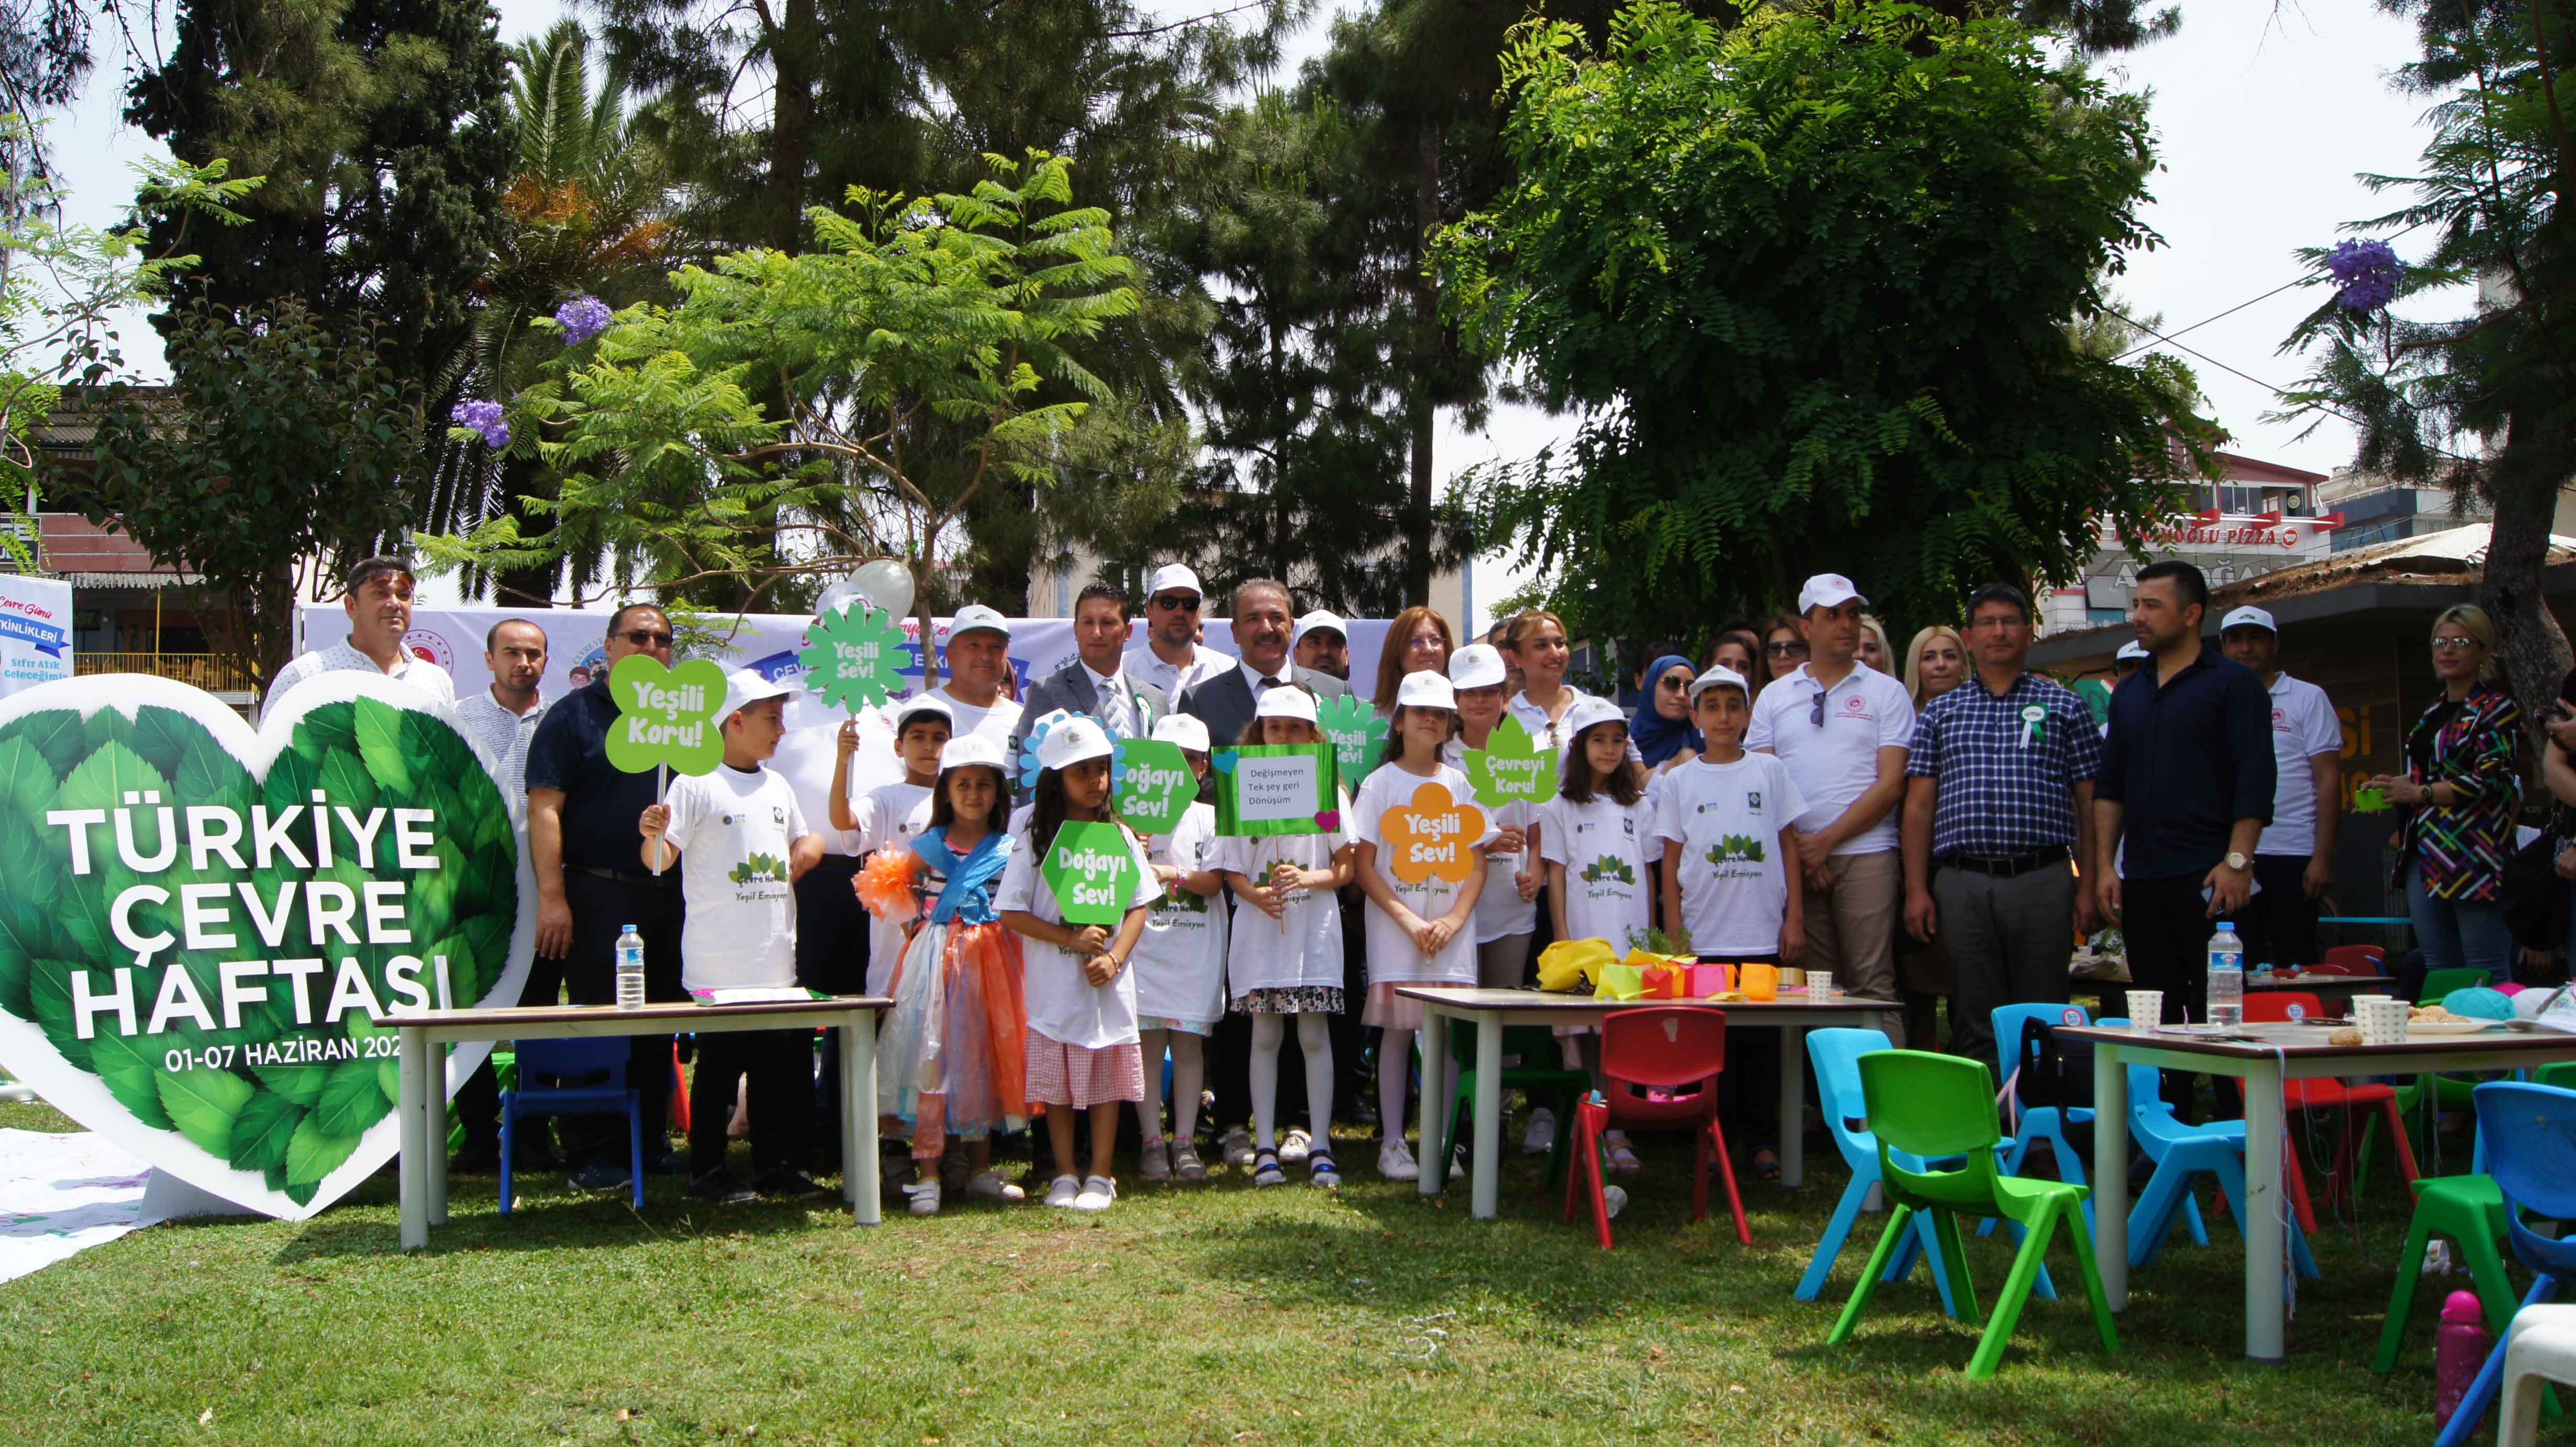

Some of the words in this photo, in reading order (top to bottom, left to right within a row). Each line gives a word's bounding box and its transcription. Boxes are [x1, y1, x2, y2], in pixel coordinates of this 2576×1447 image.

[2227, 526, 2276, 544] PİZZA
[0, 619, 58, 644] KİNLİKLERİ
[833, 642, 879, 665] Yeşili
[836, 662, 875, 679] Sev!
[631, 681, 705, 720] Yeşili
[628, 717, 703, 748] Koru!
[1326, 729, 1367, 751] Yeşili
[1250, 768, 1304, 779] Değişmeyen
[1486, 755, 1544, 778] Çevreyi
[1122, 763, 1184, 795] oğayı
[1248, 783, 1264, 791] Tek
[1266, 784, 1281, 792] şey
[1283, 781, 1300, 792] geri
[1495, 777, 1536, 793] Koru!
[1122, 795, 1168, 818] Sev!
[1249, 796, 1291, 806] Dönüşüm
[46, 789, 441, 874] TÜRKİYE
[1403, 813, 1461, 841] Yeşili
[1410, 841, 1455, 863] Sev!
[1058, 847, 1126, 882] Doğayı
[1072, 882, 1115, 906] Sev!
[1415, 883, 1449, 897] Emyon
[110, 881, 412, 968] ÇEVRE
[1172, 920, 1206, 931] Emisyon
[71, 955, 453, 1040] HAFTASI
[165, 1045, 234, 1073] 01-07
[245, 1035, 358, 1066] HAZİRAN
